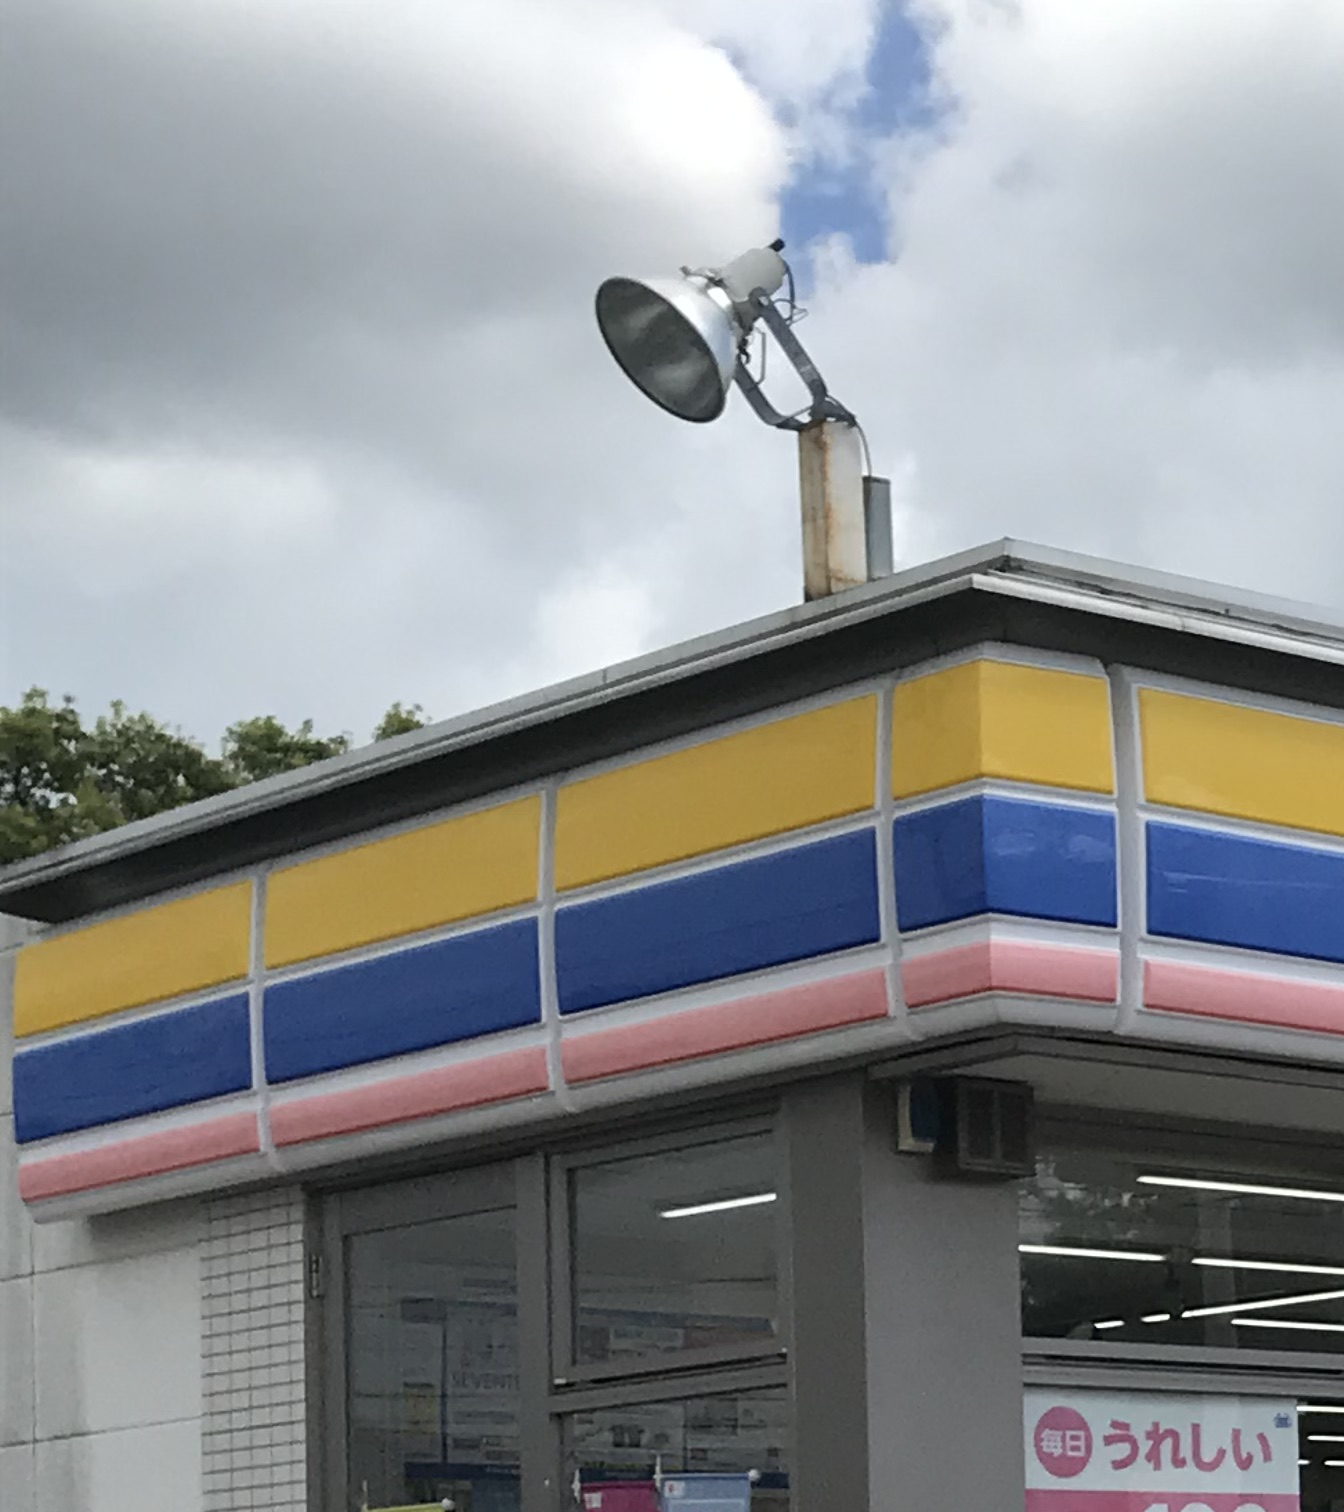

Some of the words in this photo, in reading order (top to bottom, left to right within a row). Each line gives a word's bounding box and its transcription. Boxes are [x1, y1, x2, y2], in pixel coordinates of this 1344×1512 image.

[1039, 1427, 1087, 1459] 毎日
[1102, 1417, 1273, 1473] うれしい
